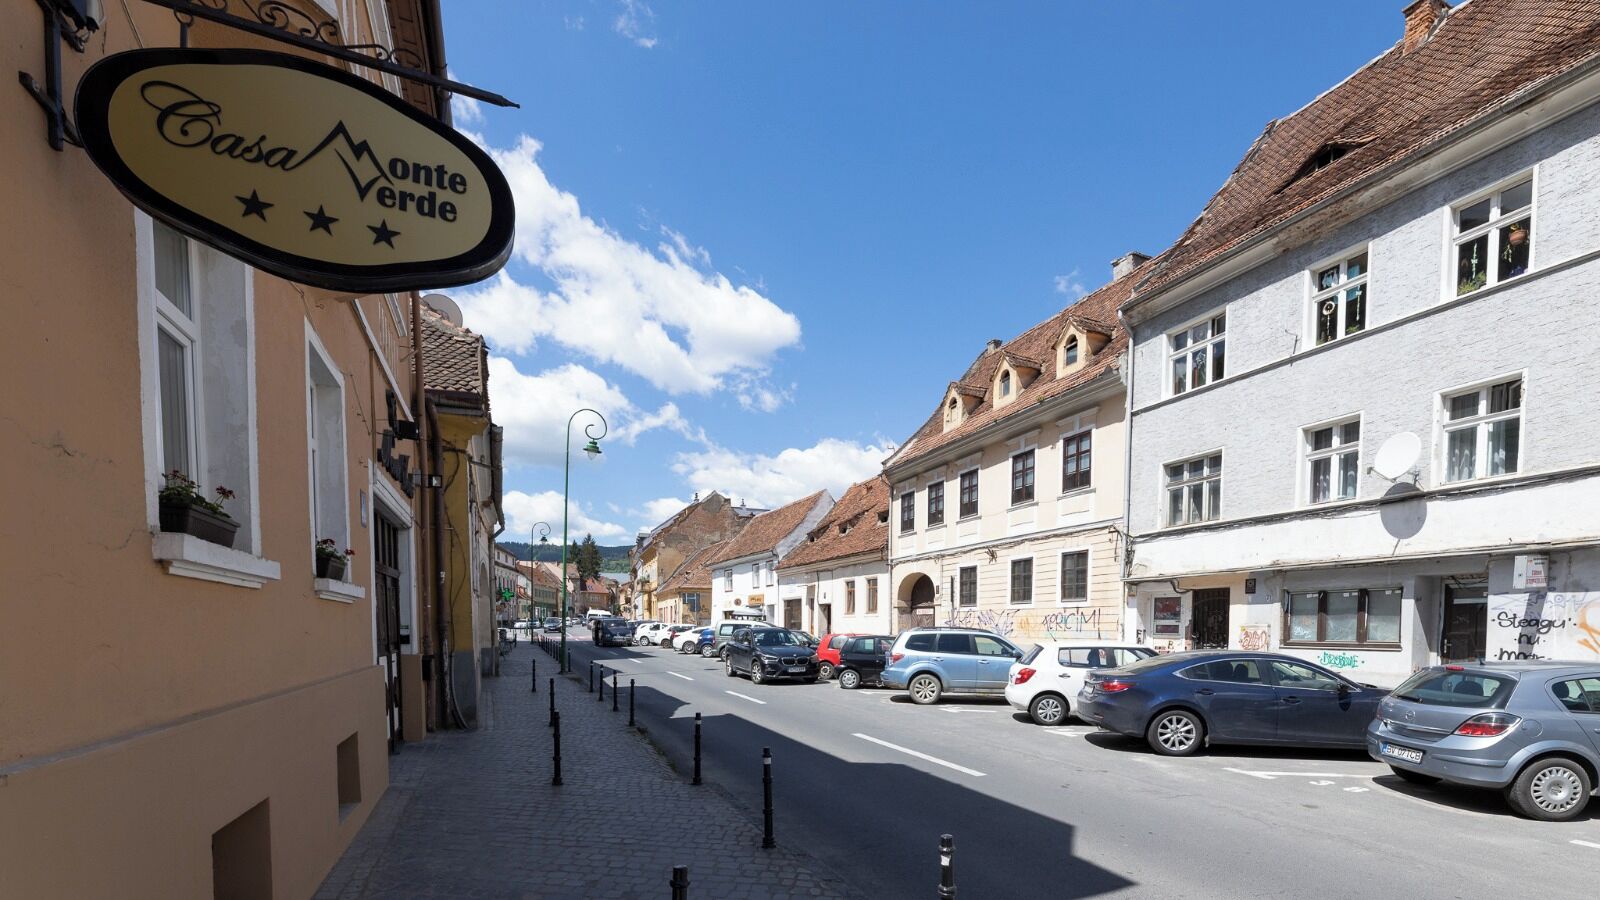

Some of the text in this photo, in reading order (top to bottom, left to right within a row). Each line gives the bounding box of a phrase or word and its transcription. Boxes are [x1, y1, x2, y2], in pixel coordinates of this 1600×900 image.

[140, 80, 467, 195] Casa Monte
[334, 148, 459, 222] Verde
